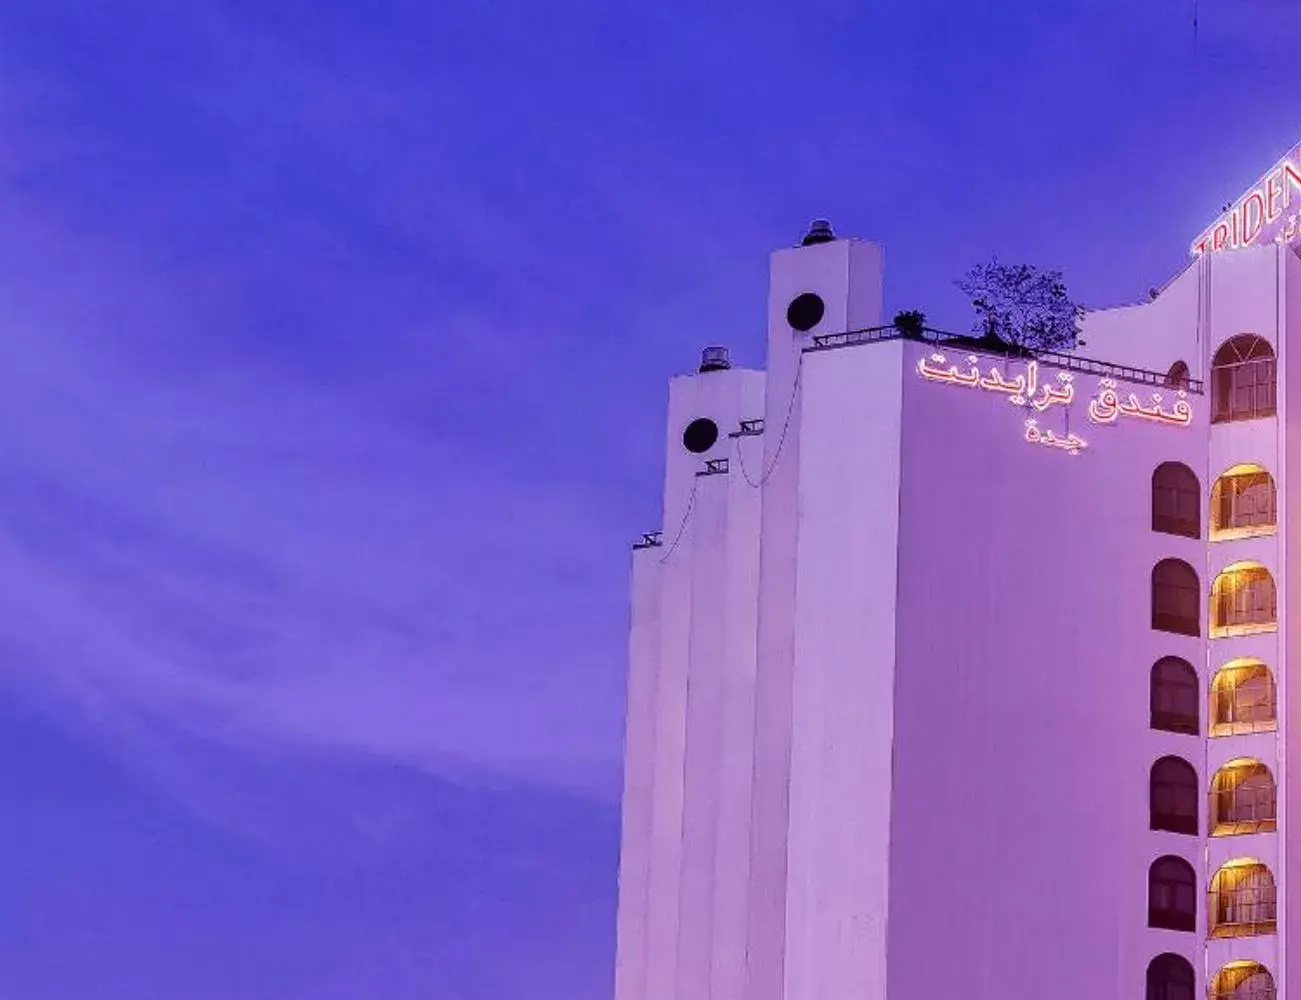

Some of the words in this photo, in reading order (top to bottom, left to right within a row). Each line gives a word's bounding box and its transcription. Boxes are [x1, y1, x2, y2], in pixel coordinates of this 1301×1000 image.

[917, 353, 1075, 411] ترايدنت
[1089, 376, 1193, 426] فندق
[1025, 419, 1088, 455] جدة
